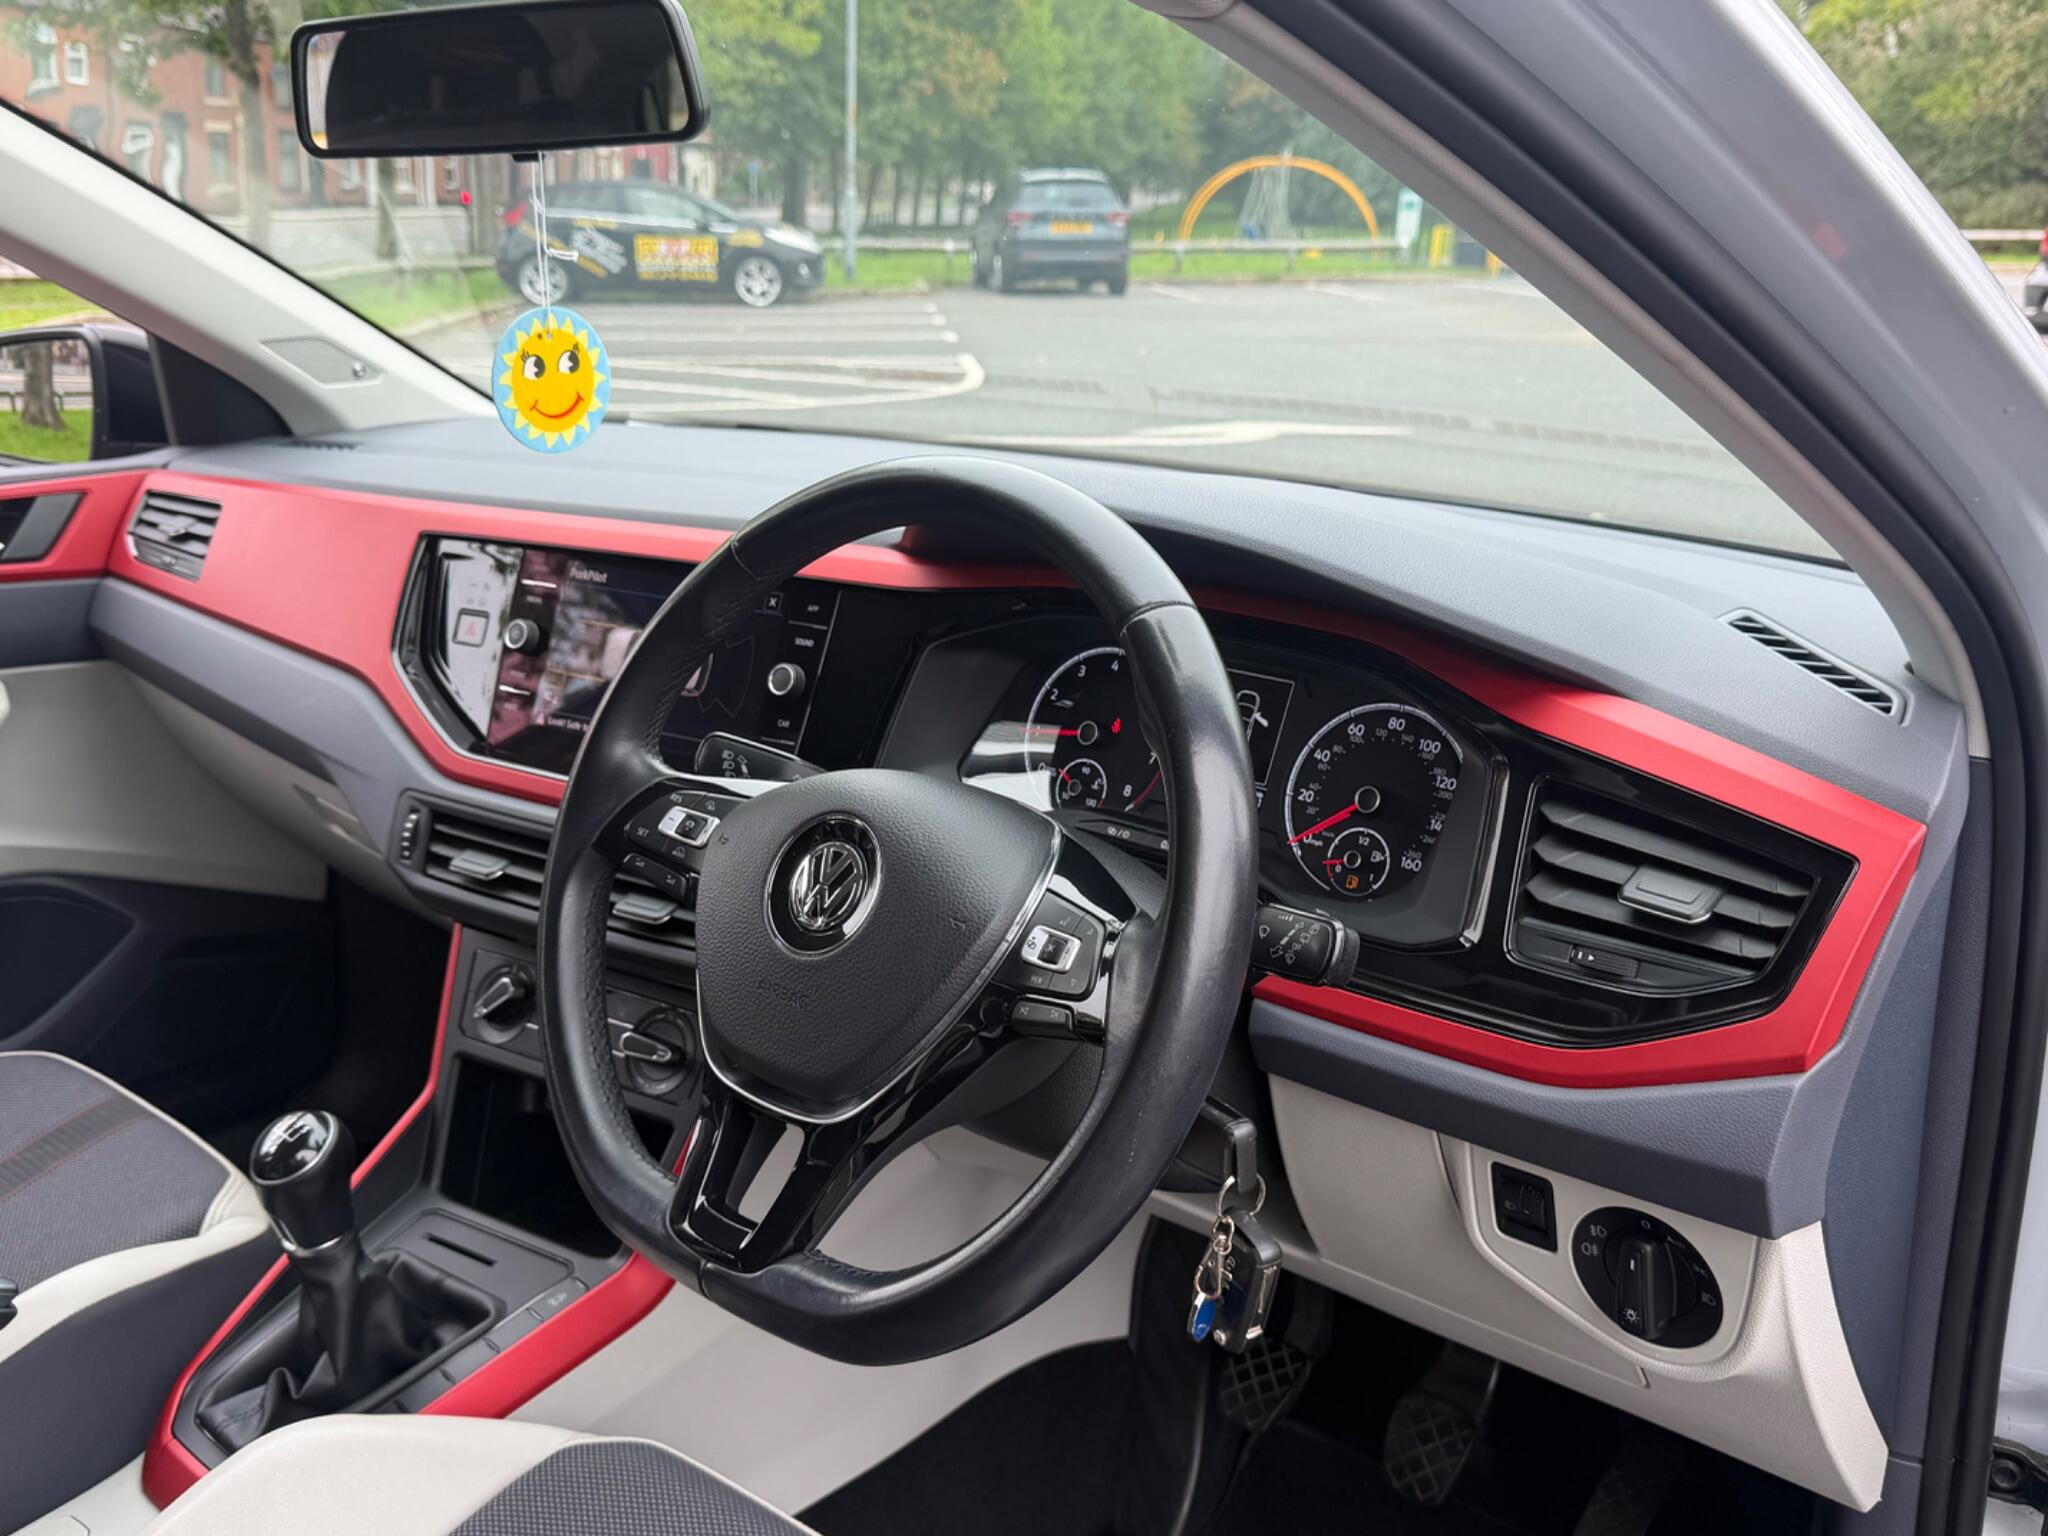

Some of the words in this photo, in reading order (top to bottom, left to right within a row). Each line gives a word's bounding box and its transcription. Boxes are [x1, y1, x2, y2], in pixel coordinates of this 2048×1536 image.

[794, 637, 815, 648] SOUND
[1077, 665, 1087, 677] 3
[1110, 659, 1120, 672] 4
[1050, 688, 1059, 700] 2
[777, 719, 790, 728] CAR
[1347, 722, 1365, 736] 60
[1388, 716, 1406, 731] 80
[1419, 738, 1441, 754] 100
[1149, 752, 1157, 764] 7
[1314, 748, 1331, 762] 40
[1435, 775, 1457, 791] 120
[1123, 784, 1132, 797] 8
[1297, 788, 1315, 803] 20
[1358, 836, 1370, 847] 1/2
[1400, 856, 1422, 872] 160
